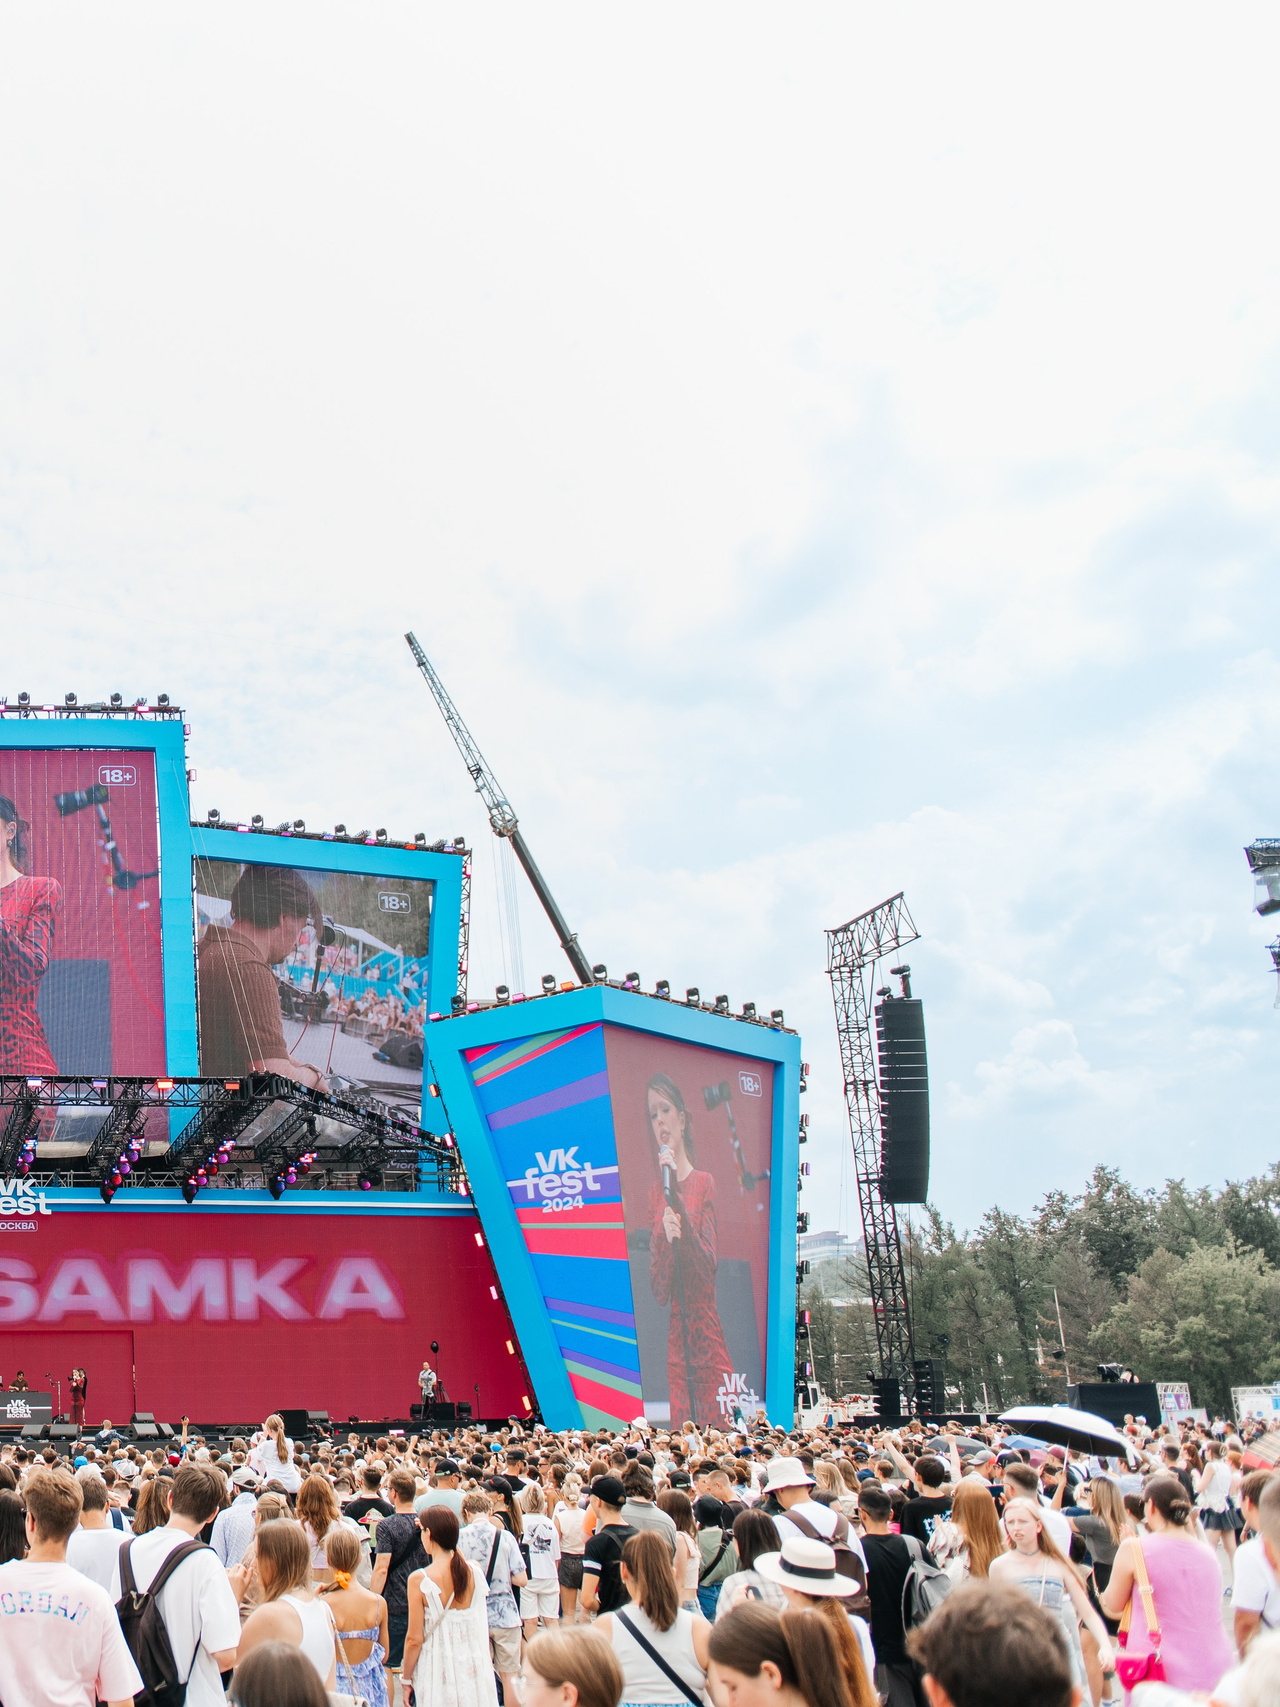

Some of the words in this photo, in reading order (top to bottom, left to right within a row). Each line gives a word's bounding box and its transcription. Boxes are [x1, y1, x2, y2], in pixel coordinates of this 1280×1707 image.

[101, 769, 133, 783] 18+
[380, 895, 408, 910] 18+
[740, 1075, 760, 1092] 18+
[534, 1145, 582, 1174] VK
[524, 1162, 601, 1199] fest
[541, 1194, 585, 1213] 2024
[722, 1372, 749, 1393] VK
[6, 1404, 32, 1414] fest
[10, 1399, 27, 1407] VK
